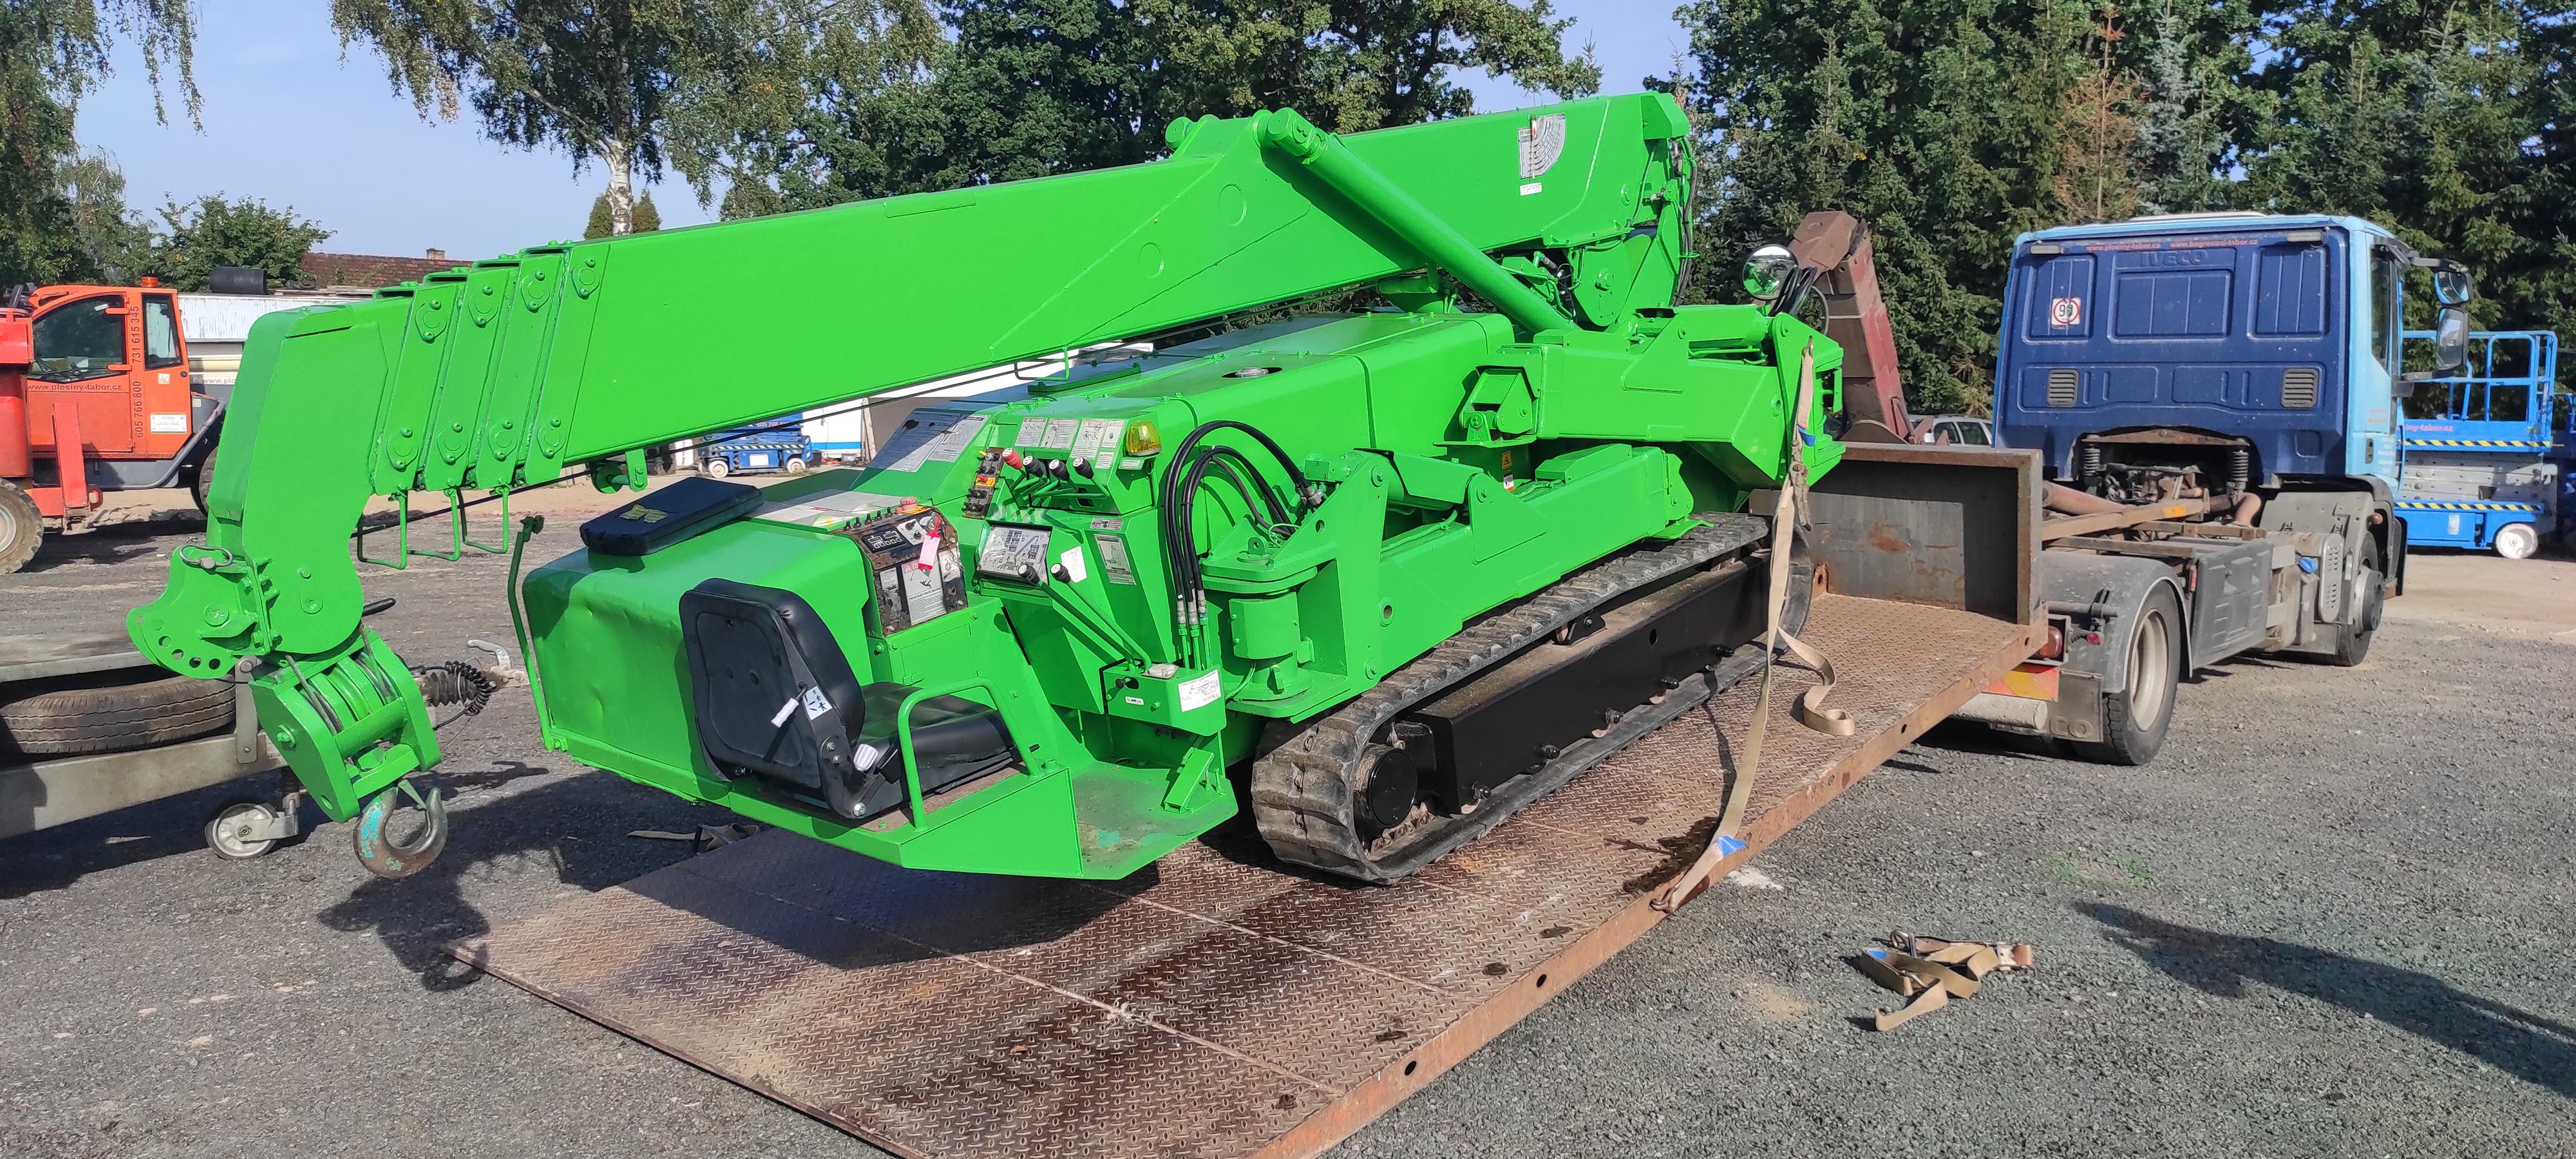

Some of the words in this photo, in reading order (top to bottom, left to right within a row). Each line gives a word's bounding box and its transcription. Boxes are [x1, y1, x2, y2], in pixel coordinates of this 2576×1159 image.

[2140, 250, 2207, 266] IVECO
[131, 306, 139, 324] 345
[131, 326, 140, 343] 615
[133, 348, 141, 363] 731
[133, 381, 141, 398] 800
[135, 422, 143, 438] 605
